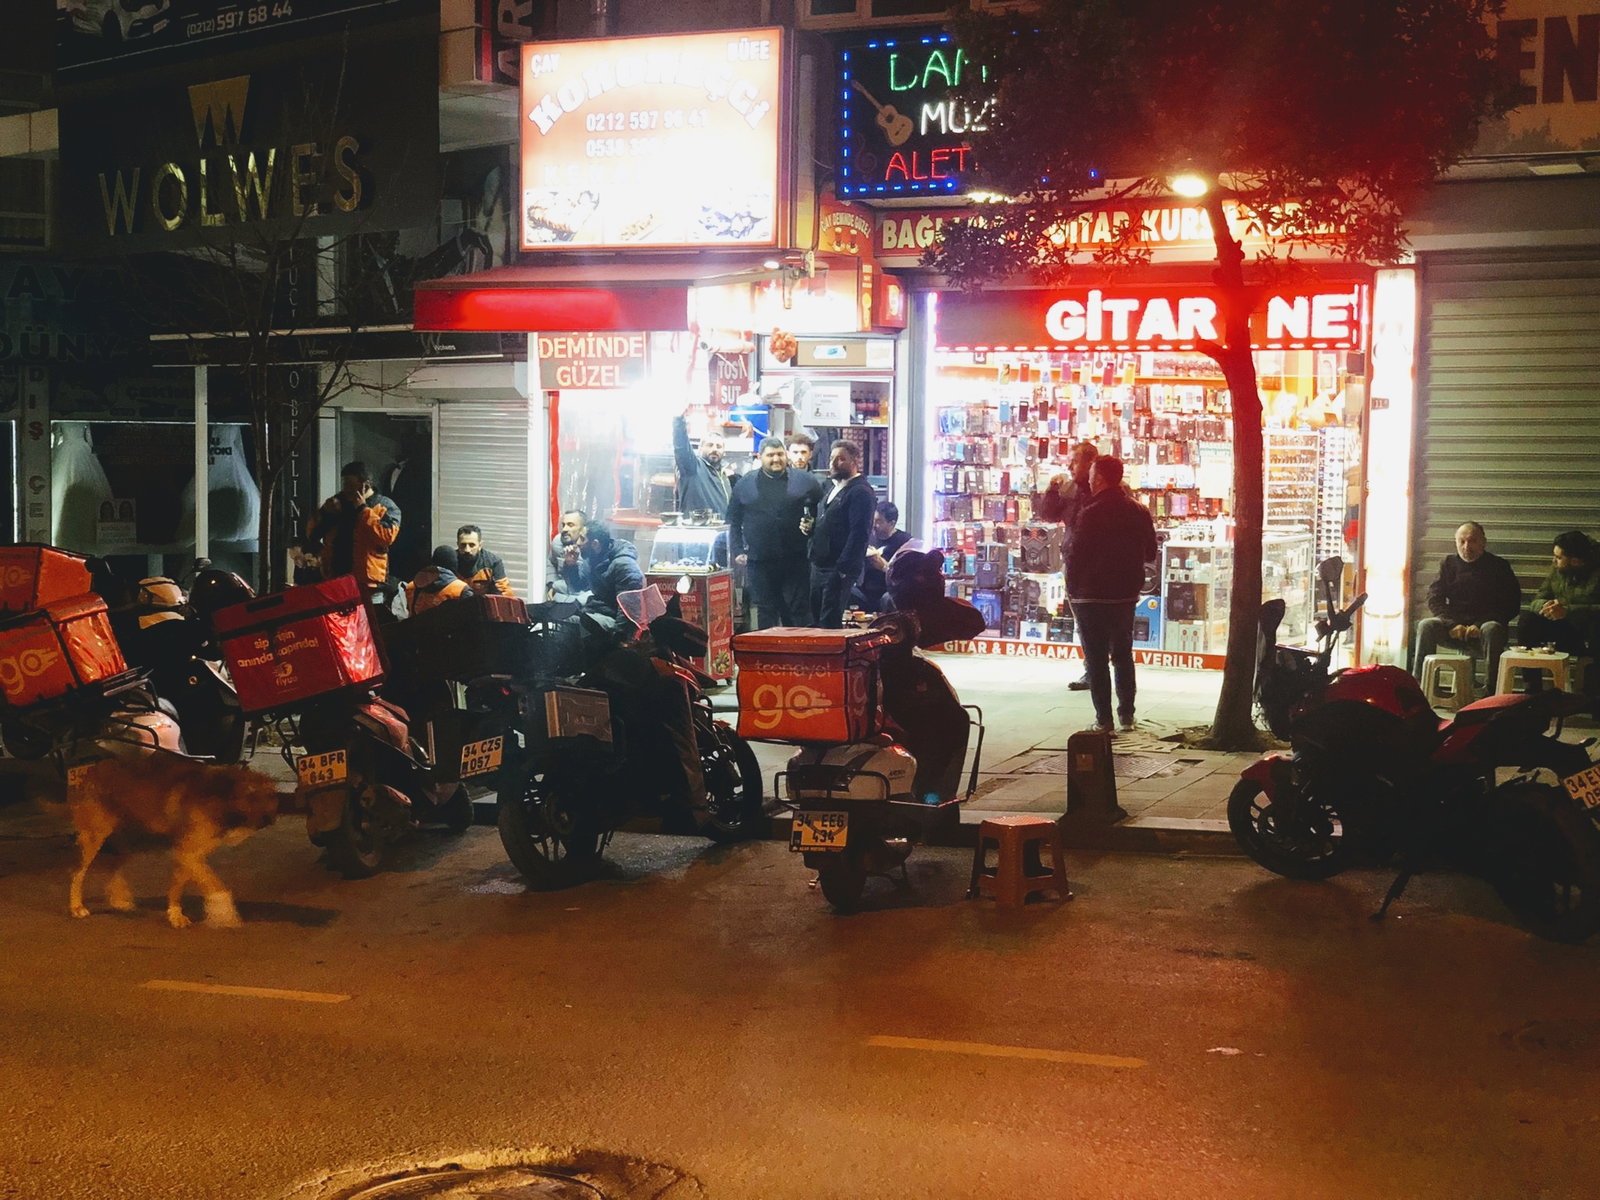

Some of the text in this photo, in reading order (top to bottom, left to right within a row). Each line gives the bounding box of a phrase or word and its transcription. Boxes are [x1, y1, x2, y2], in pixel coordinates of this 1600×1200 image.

[247, 5, 268, 25] 68
[271, 2, 293, 19] 44
[530, 54, 561, 79] ÇAY
[586, 112, 626, 132] 0212
[628, 110, 659, 130] 597
[884, 145, 980, 181] ALET
[98, 135, 362, 236] WOLWES
[1045, 288, 1218, 342] GİTAR
[537, 331, 643, 359] DEMİNDE
[555, 360, 629, 387] GÜZEL
[943, 640, 987, 655] GİTAR
[991, 643, 1002, 656] &
[1005, 643, 1080, 661] BAĞLAMA
[1141, 651, 1204, 669] VERİLİR
[752, 684, 832, 730] go
[464, 738, 501, 757] 34 CZS
[300, 752, 345, 772] 34 BFR
[470, 755, 491, 771] 057
[1567, 775, 1587, 794] 34
[797, 814, 812, 828] 34
